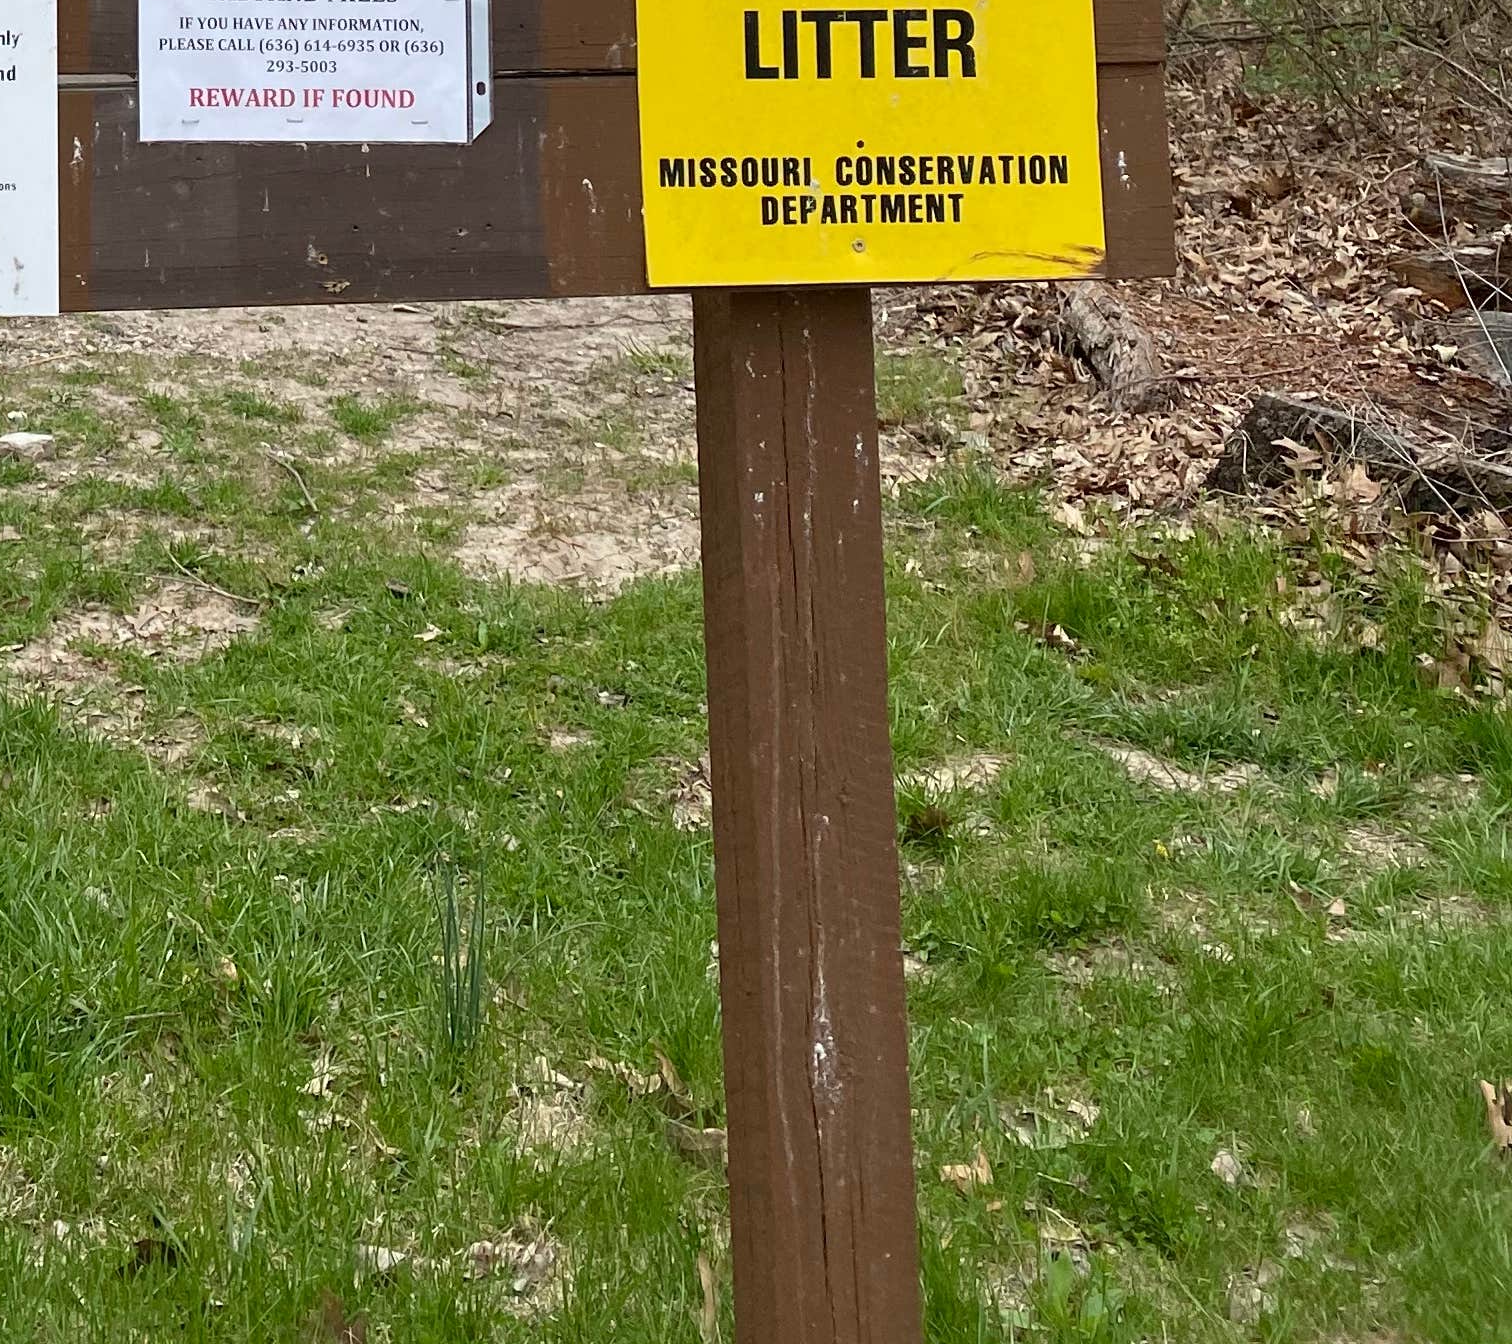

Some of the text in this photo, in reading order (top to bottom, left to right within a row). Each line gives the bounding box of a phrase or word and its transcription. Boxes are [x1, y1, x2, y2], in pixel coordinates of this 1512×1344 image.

[180, 17, 423, 32] IF YOU HAVE ANY INFORMATION,
[160, 38, 443, 55] PLEASE CALL (636) 614-6935 OR (636)
[744, 9, 976, 79] LITTER
[267, 61, 336, 73] 293-5003
[190, 88, 414, 108] REWARD IF FOUND
[660, 155, 1068, 187] MISSOURI CONSERVATION
[762, 194, 964, 225] DEPARTMENT
